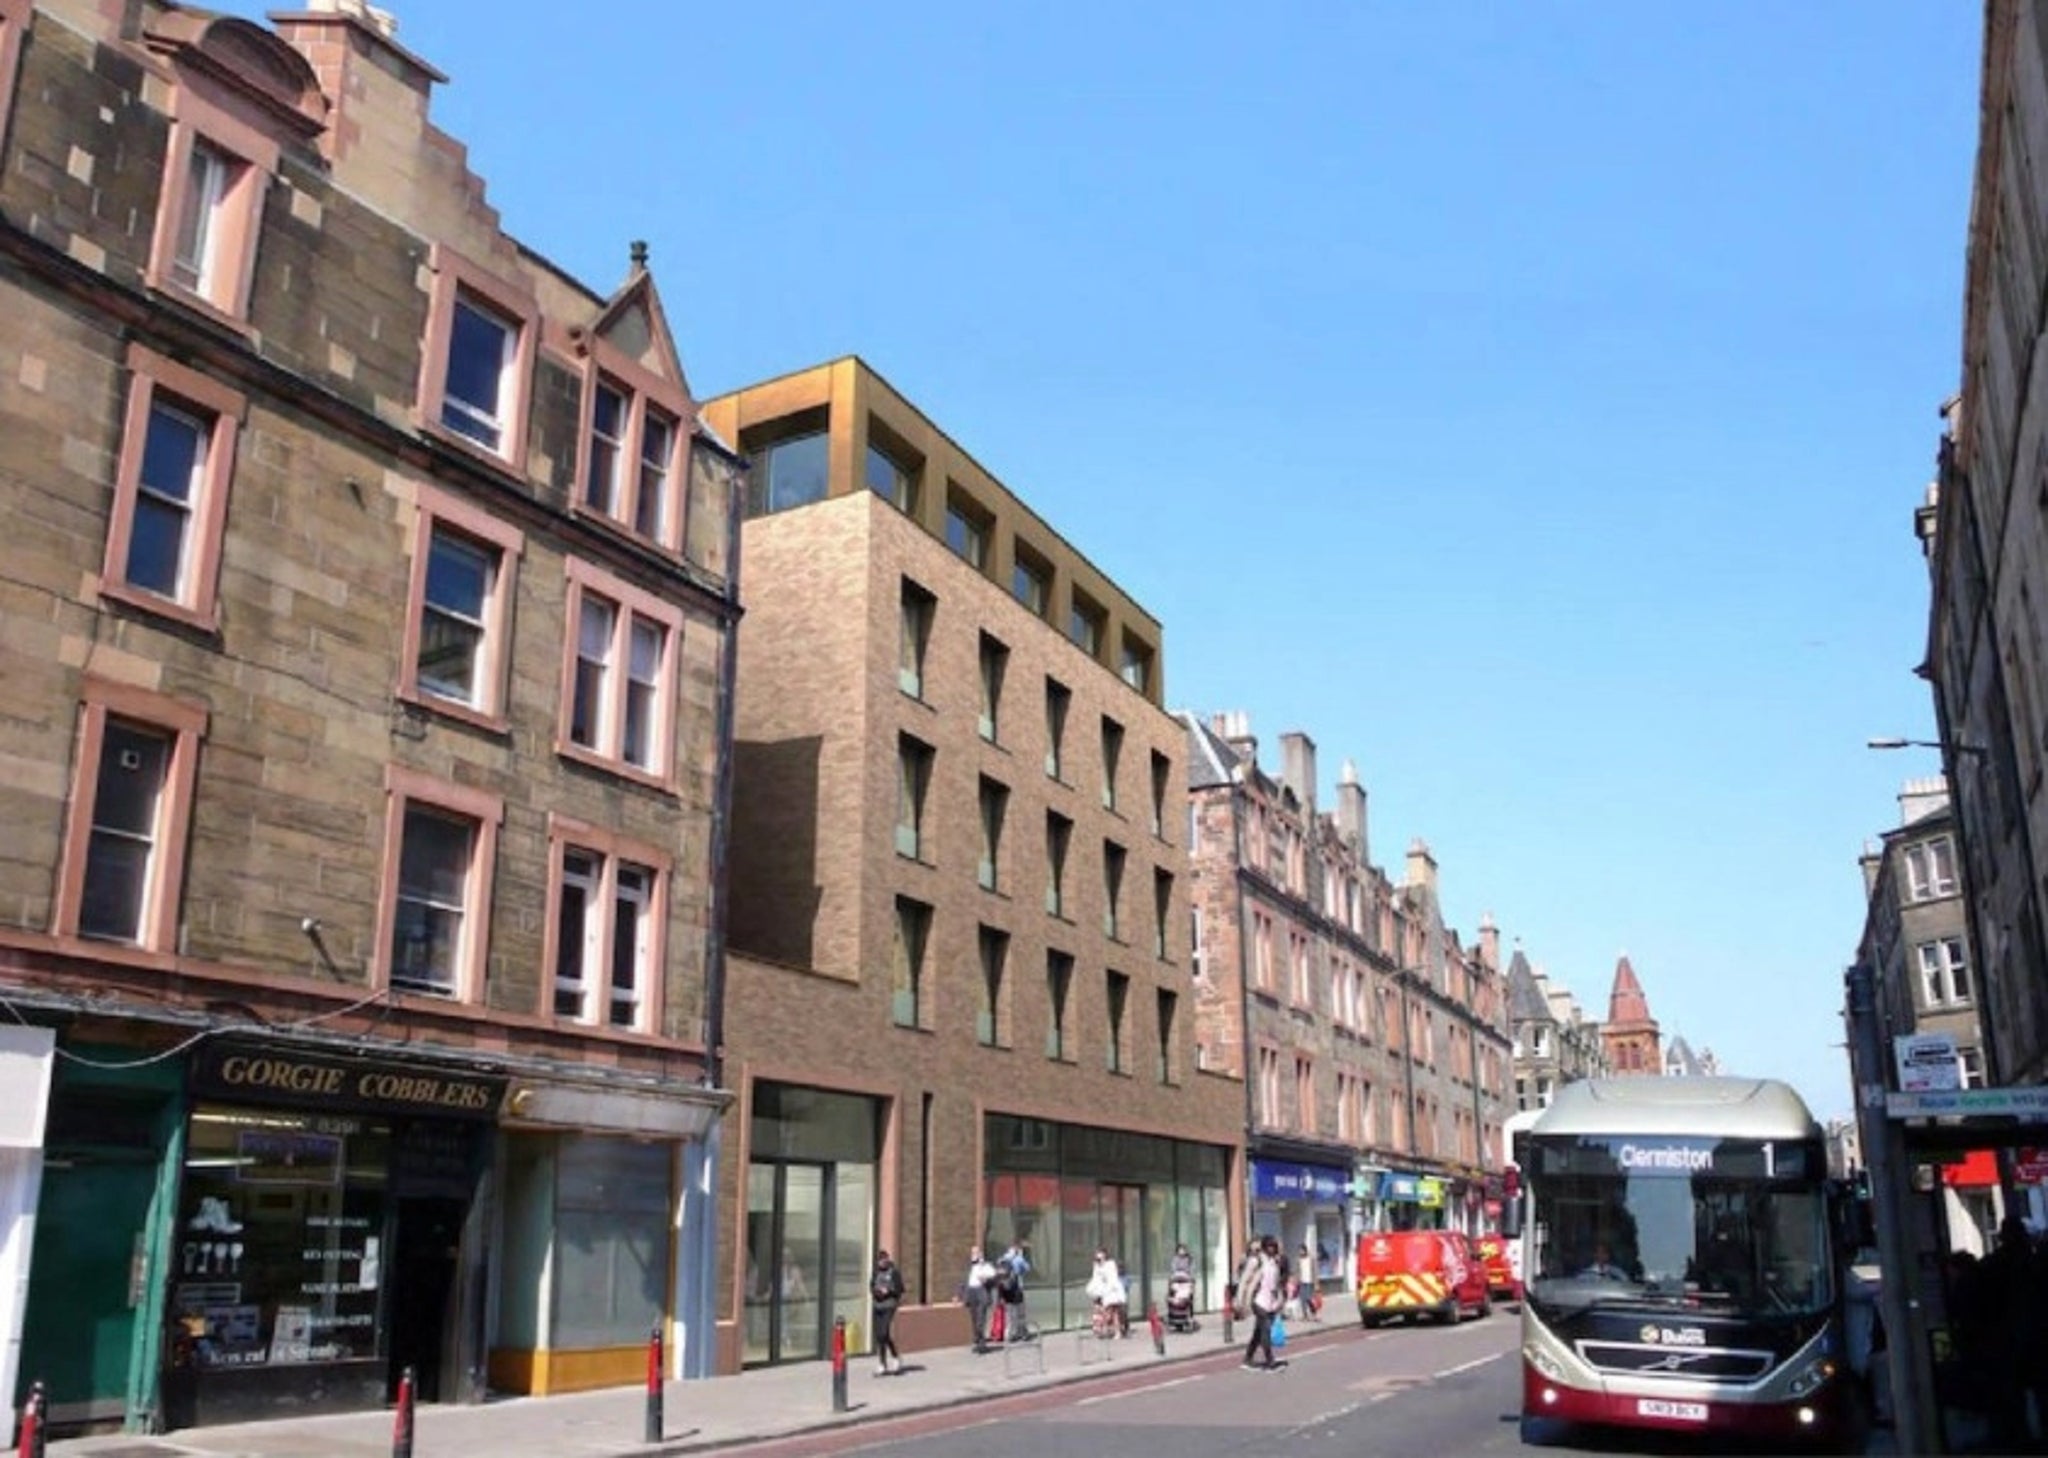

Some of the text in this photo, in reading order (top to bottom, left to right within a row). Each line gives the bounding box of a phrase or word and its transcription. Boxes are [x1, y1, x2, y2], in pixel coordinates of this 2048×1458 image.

[222, 1056, 491, 1108] GORGIE COBBLERS
[1619, 1141, 1775, 1178] Clermiston 1
